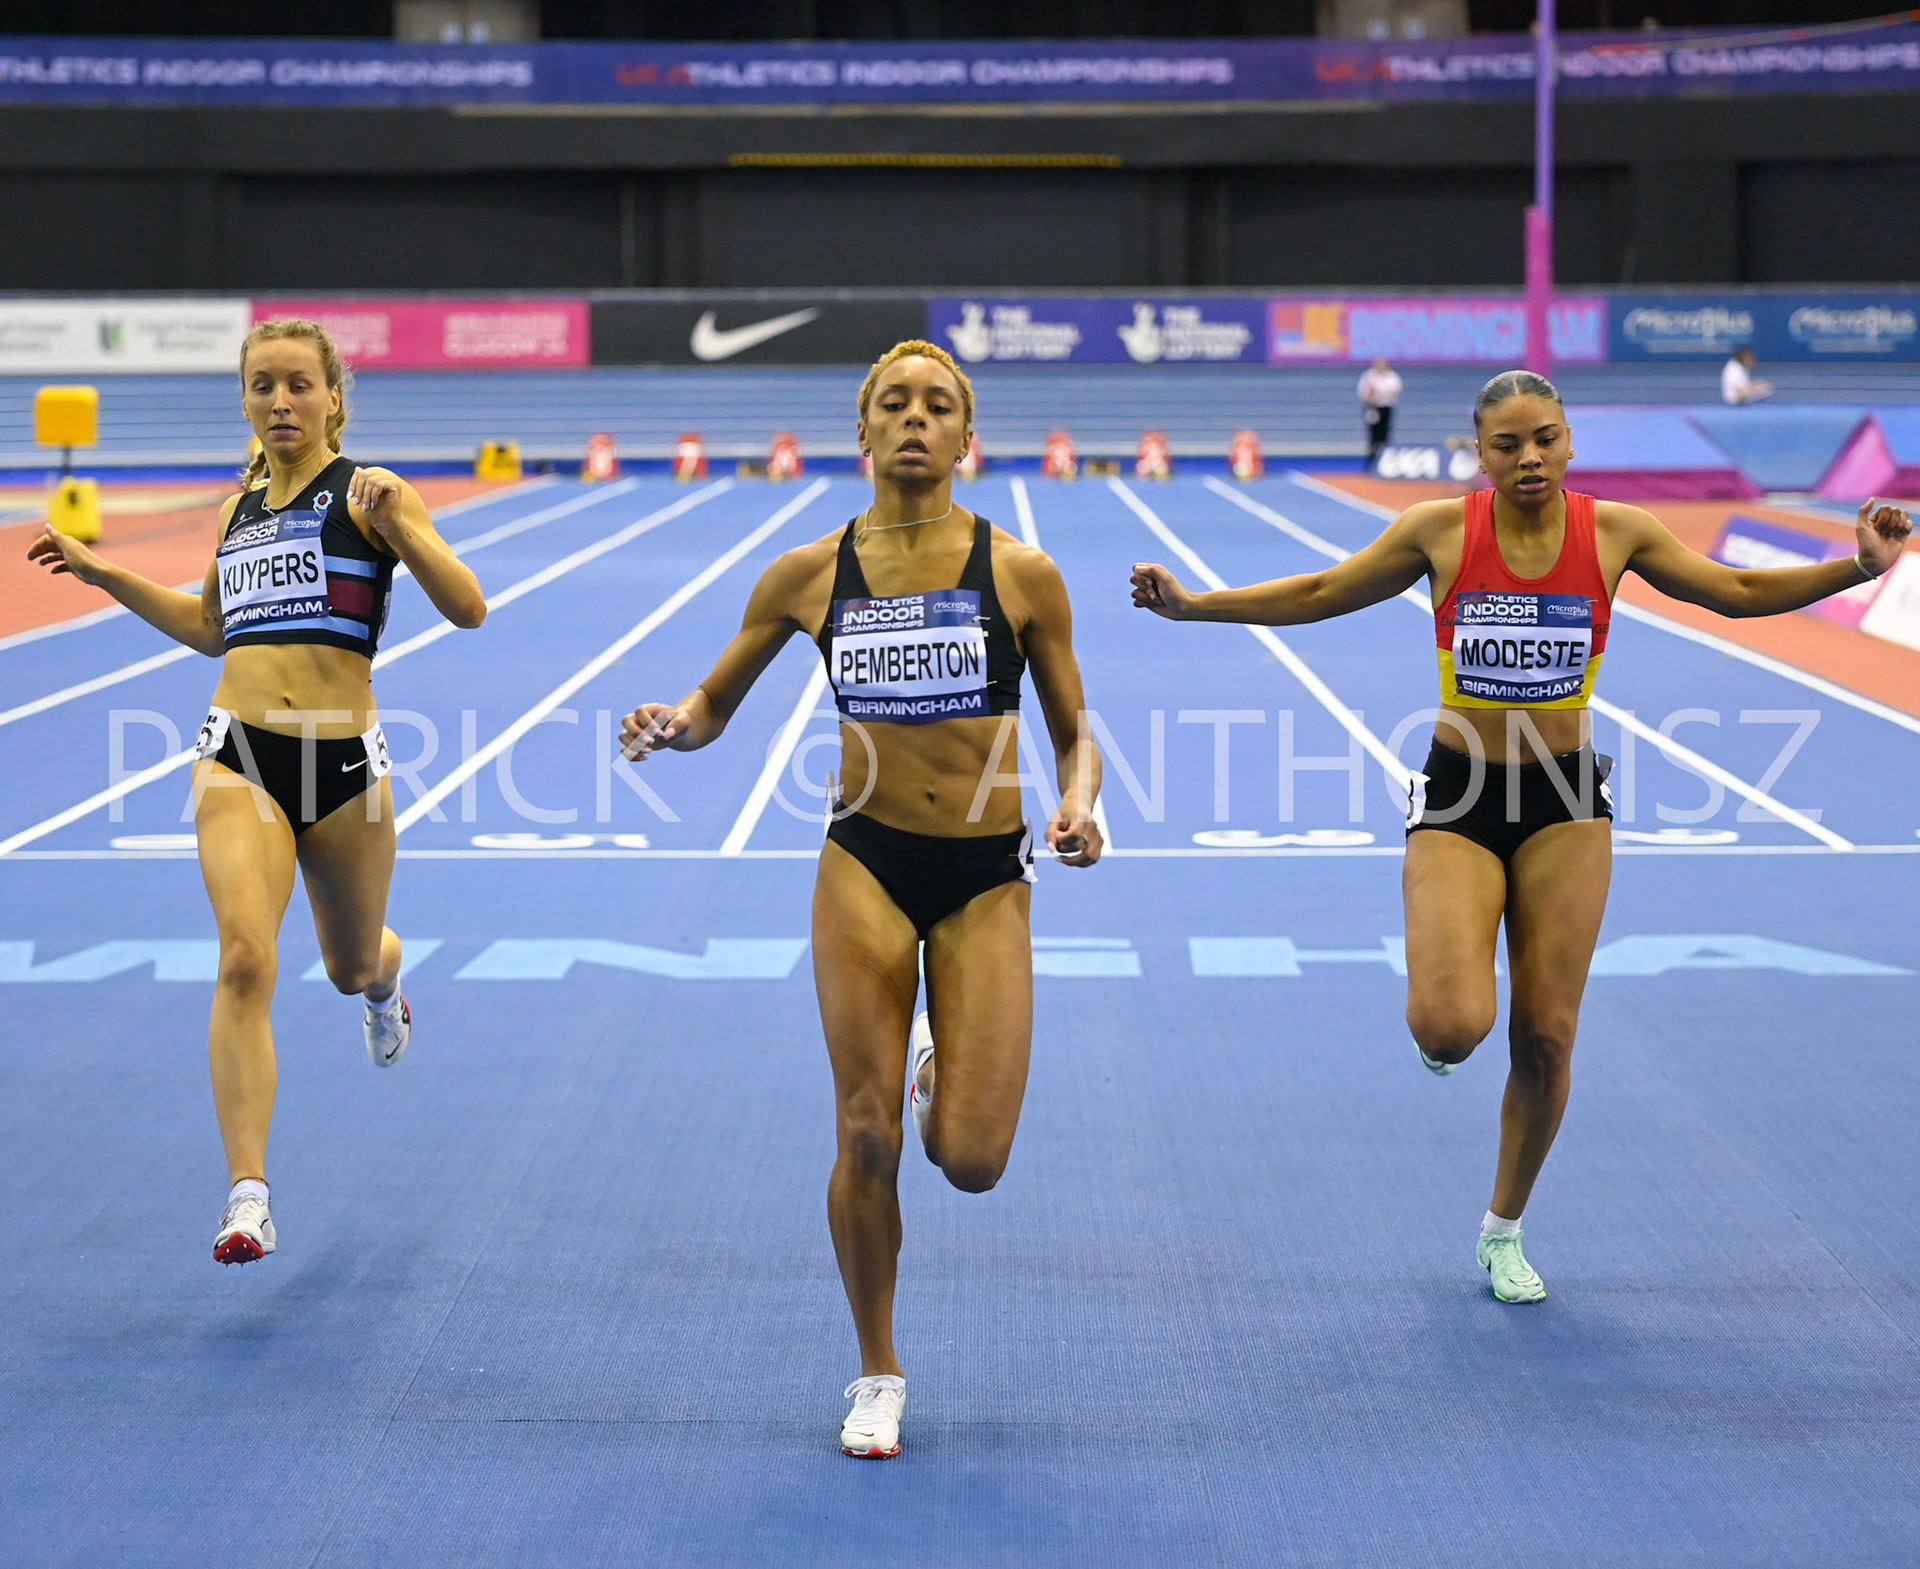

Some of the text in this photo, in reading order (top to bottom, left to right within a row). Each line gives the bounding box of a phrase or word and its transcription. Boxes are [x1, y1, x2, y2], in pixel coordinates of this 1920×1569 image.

[1, 58, 137, 84] THLETICS
[224, 550, 319, 599] KUYPERS
[225, 600, 323, 629] BIRMINGHAM
[842, 605, 925, 626] INDOOR
[1463, 616, 1538, 625] CHAMPIONSHIPS
[1464, 603, 1538, 617] INDOOR
[842, 619, 925, 634] CHAMPIONSHIPS
[840, 641, 979, 685] PEMBERTON
[1460, 638, 1585, 670] MODESTE
[1461, 680, 1580, 698] BIRMINGHAM
[848, 694, 982, 716] BIRMINGHAM
